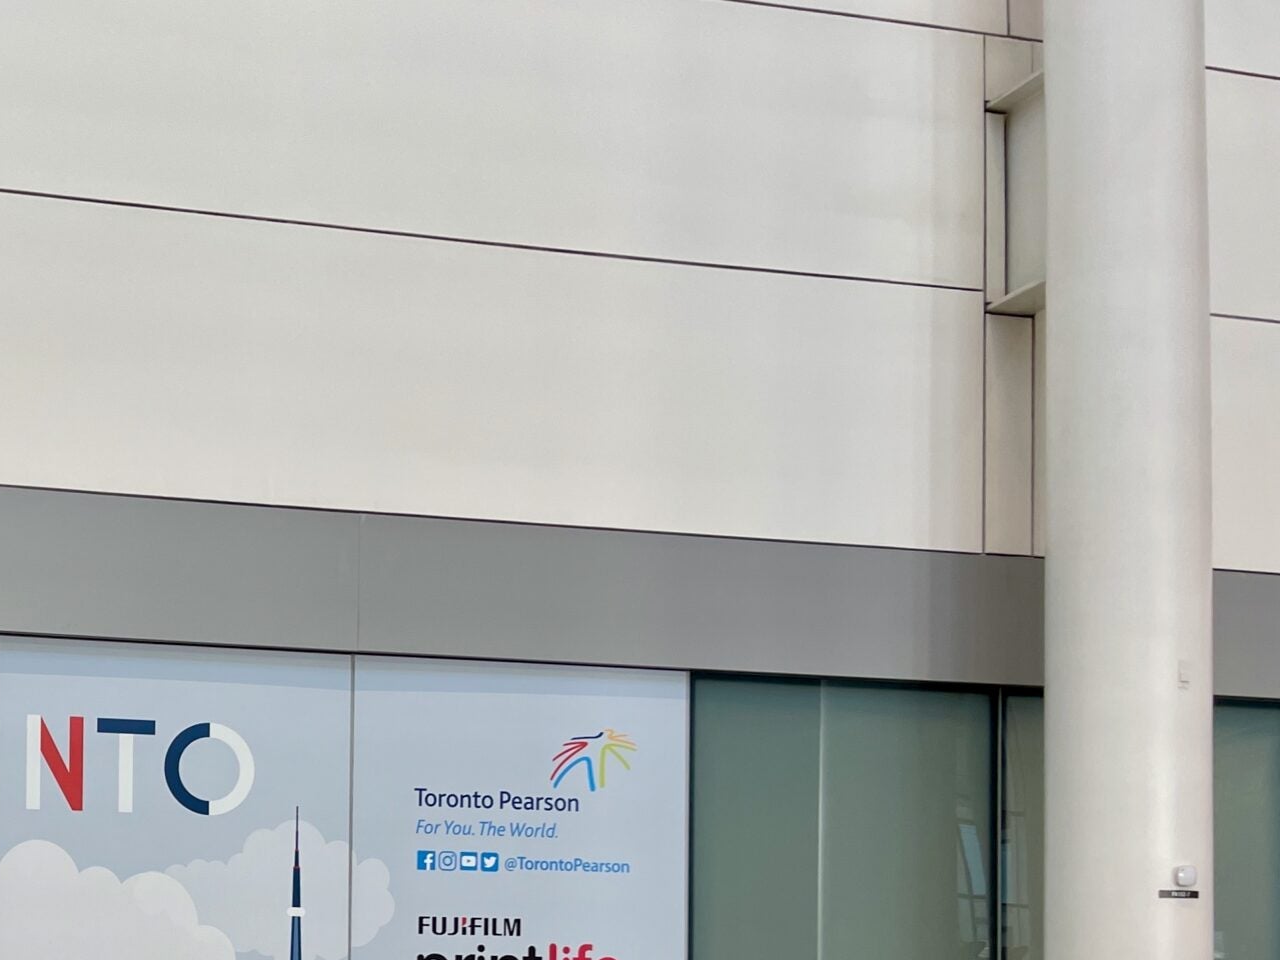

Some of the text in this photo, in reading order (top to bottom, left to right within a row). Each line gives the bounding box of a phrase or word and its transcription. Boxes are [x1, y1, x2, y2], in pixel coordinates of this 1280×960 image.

[414, 788, 579, 811] Toronto Pearson
[416, 819, 558, 838] For You. The World.
[505, 856, 629, 873] @TorontoPearson
[418, 916, 521, 936] FUJIFILM
